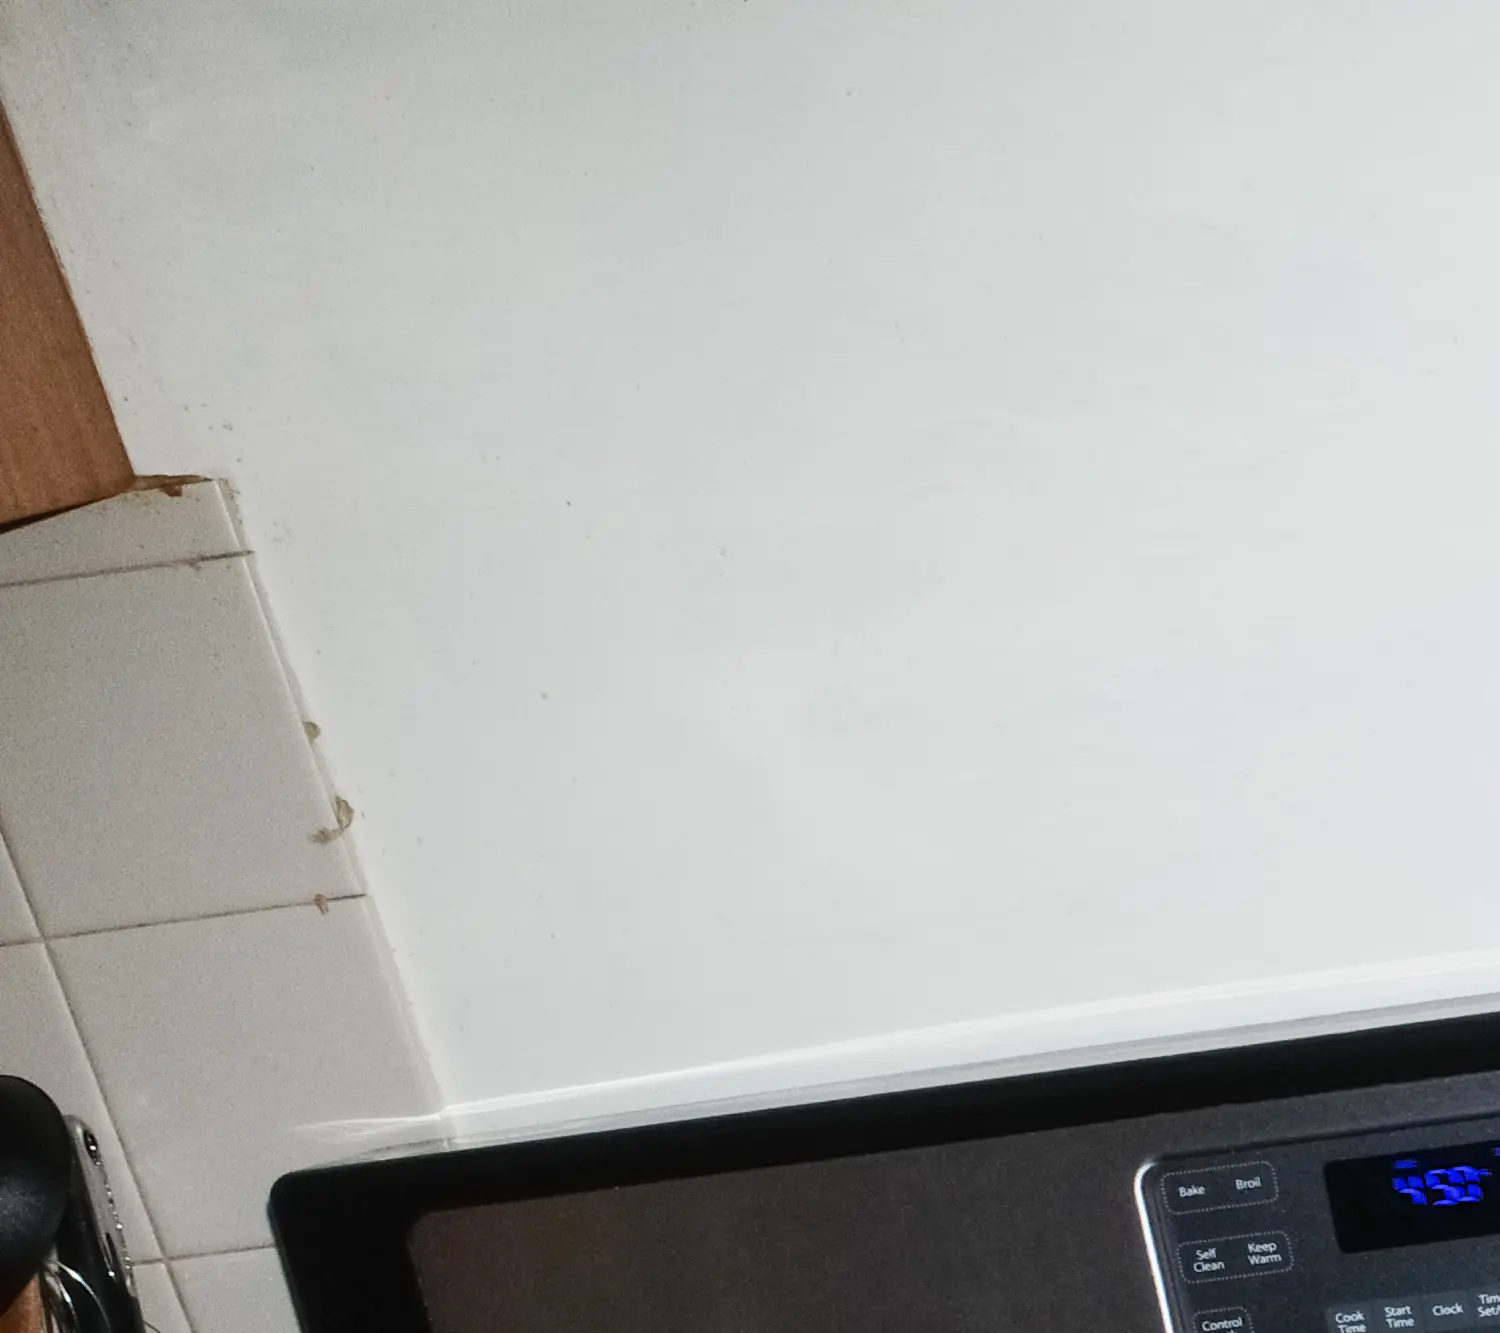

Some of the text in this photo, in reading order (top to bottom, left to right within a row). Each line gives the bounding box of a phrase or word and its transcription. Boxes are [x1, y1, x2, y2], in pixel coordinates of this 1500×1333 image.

[1235, 1176, 1262, 1190] Broil
[1178, 1184, 1206, 1198] Bake
[1195, 1247, 1217, 1260] Self
[1247, 1242, 1278, 1254] Keep
[1247, 1253, 1283, 1266] Warm
[1193, 1261, 1225, 1273] Clean
[1384, 1305, 1413, 1318] Start
[1432, 1302, 1464, 1316] Clock
[1335, 1310, 1365, 1323] Cook
[1202, 1316, 1244, 1332] Control
[1386, 1318, 1416, 1329] Time
